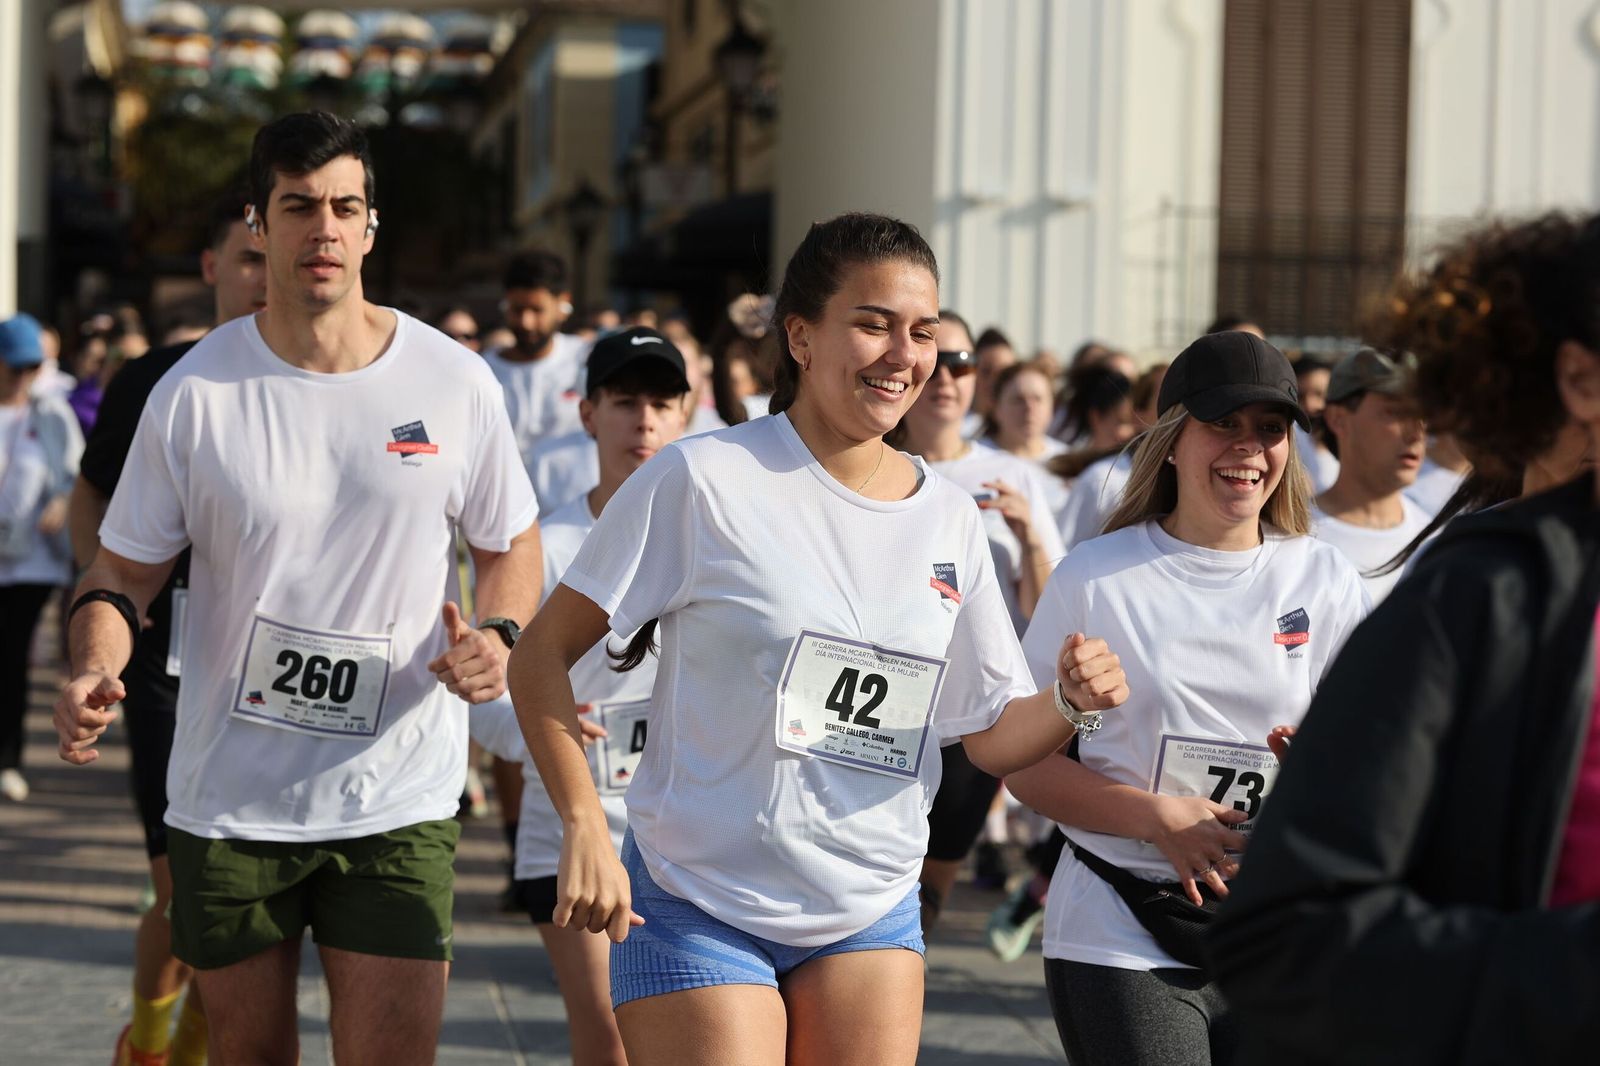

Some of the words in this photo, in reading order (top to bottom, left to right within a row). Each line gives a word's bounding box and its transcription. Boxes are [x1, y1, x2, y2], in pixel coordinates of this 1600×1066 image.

[272, 628, 302, 640] CARRERA
[283, 638, 333, 654] INTERNACIONAL
[815, 649, 827, 659] DÍA
[827, 652, 876, 669] INTERNACIONAL
[887, 665, 896, 673] LA
[897, 667, 920, 679] MUJER
[818, 642, 847, 654] CARRERA
[848, 649, 900, 666] MCARTHURGLEN
[900, 659, 928, 672] MÁLAGA
[271, 649, 358, 704] 260
[825, 666, 889, 730] 42
[825, 722, 846, 734] BENITEZ
[846, 728, 870, 740] GALLEGO,
[871, 732, 895, 745] CARMEN
[860, 752, 879, 761] ARMANI
[890, 748, 907, 756] HARIBO
[1183, 752, 1195, 760] DÍA
[1196, 754, 1251, 767] INTERNACIONAL
[1253, 761, 1262, 769] DE
[1185, 745, 1217, 754] CARRERA
[1218, 749, 1274, 762] MCARTHURGLEN
[1207, 765, 1265, 821] 73
